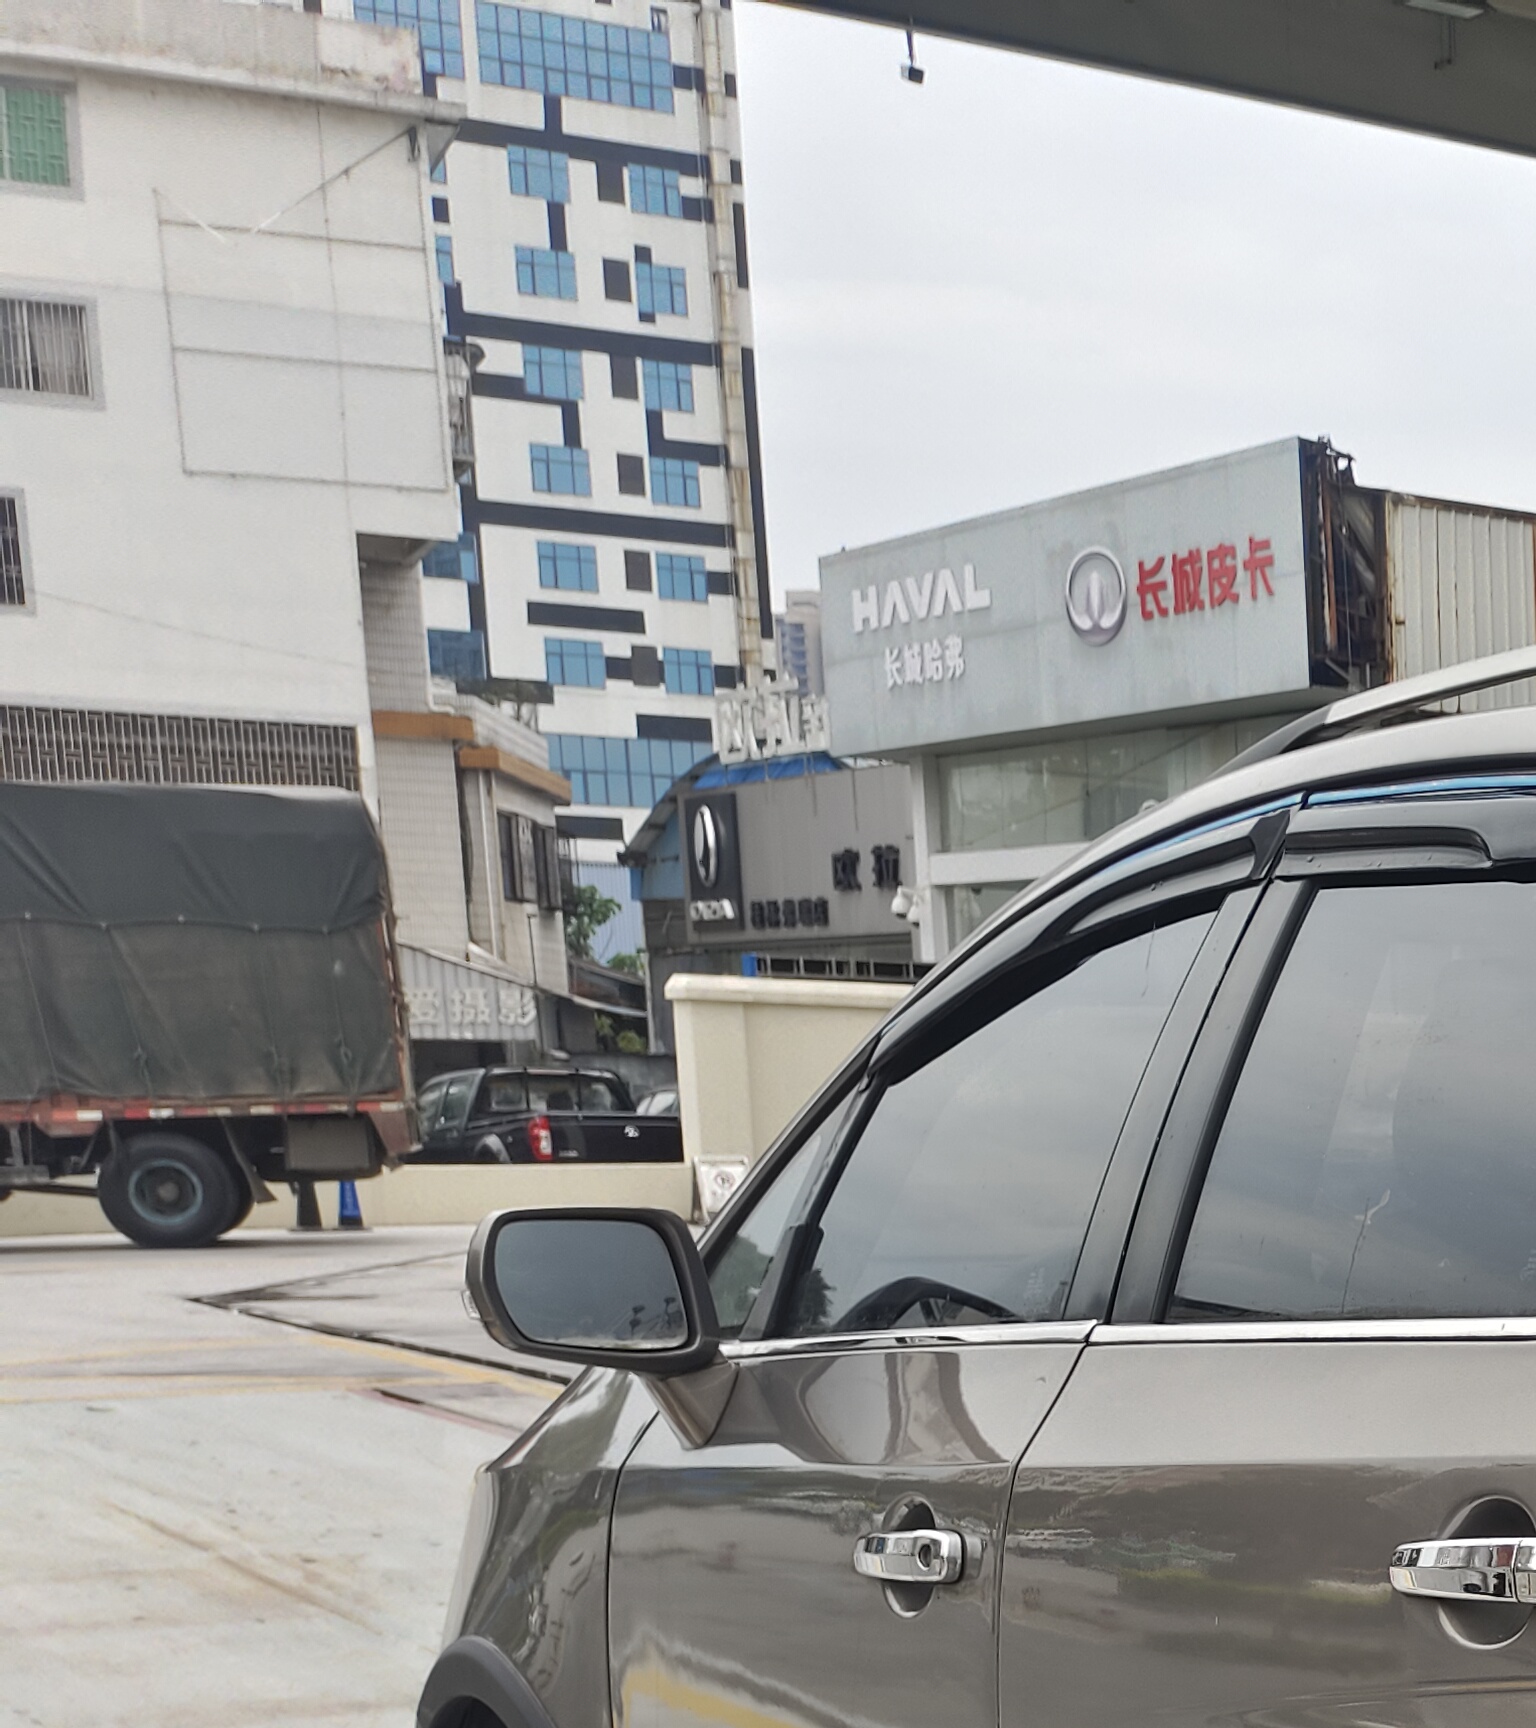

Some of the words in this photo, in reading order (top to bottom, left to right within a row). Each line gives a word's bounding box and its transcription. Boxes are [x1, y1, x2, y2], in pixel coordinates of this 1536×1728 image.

[852, 563, 991, 633] HAVAL
[1136, 536, 1275, 621] 长城皮卡
[883, 634, 966, 690] 长城哈弗
